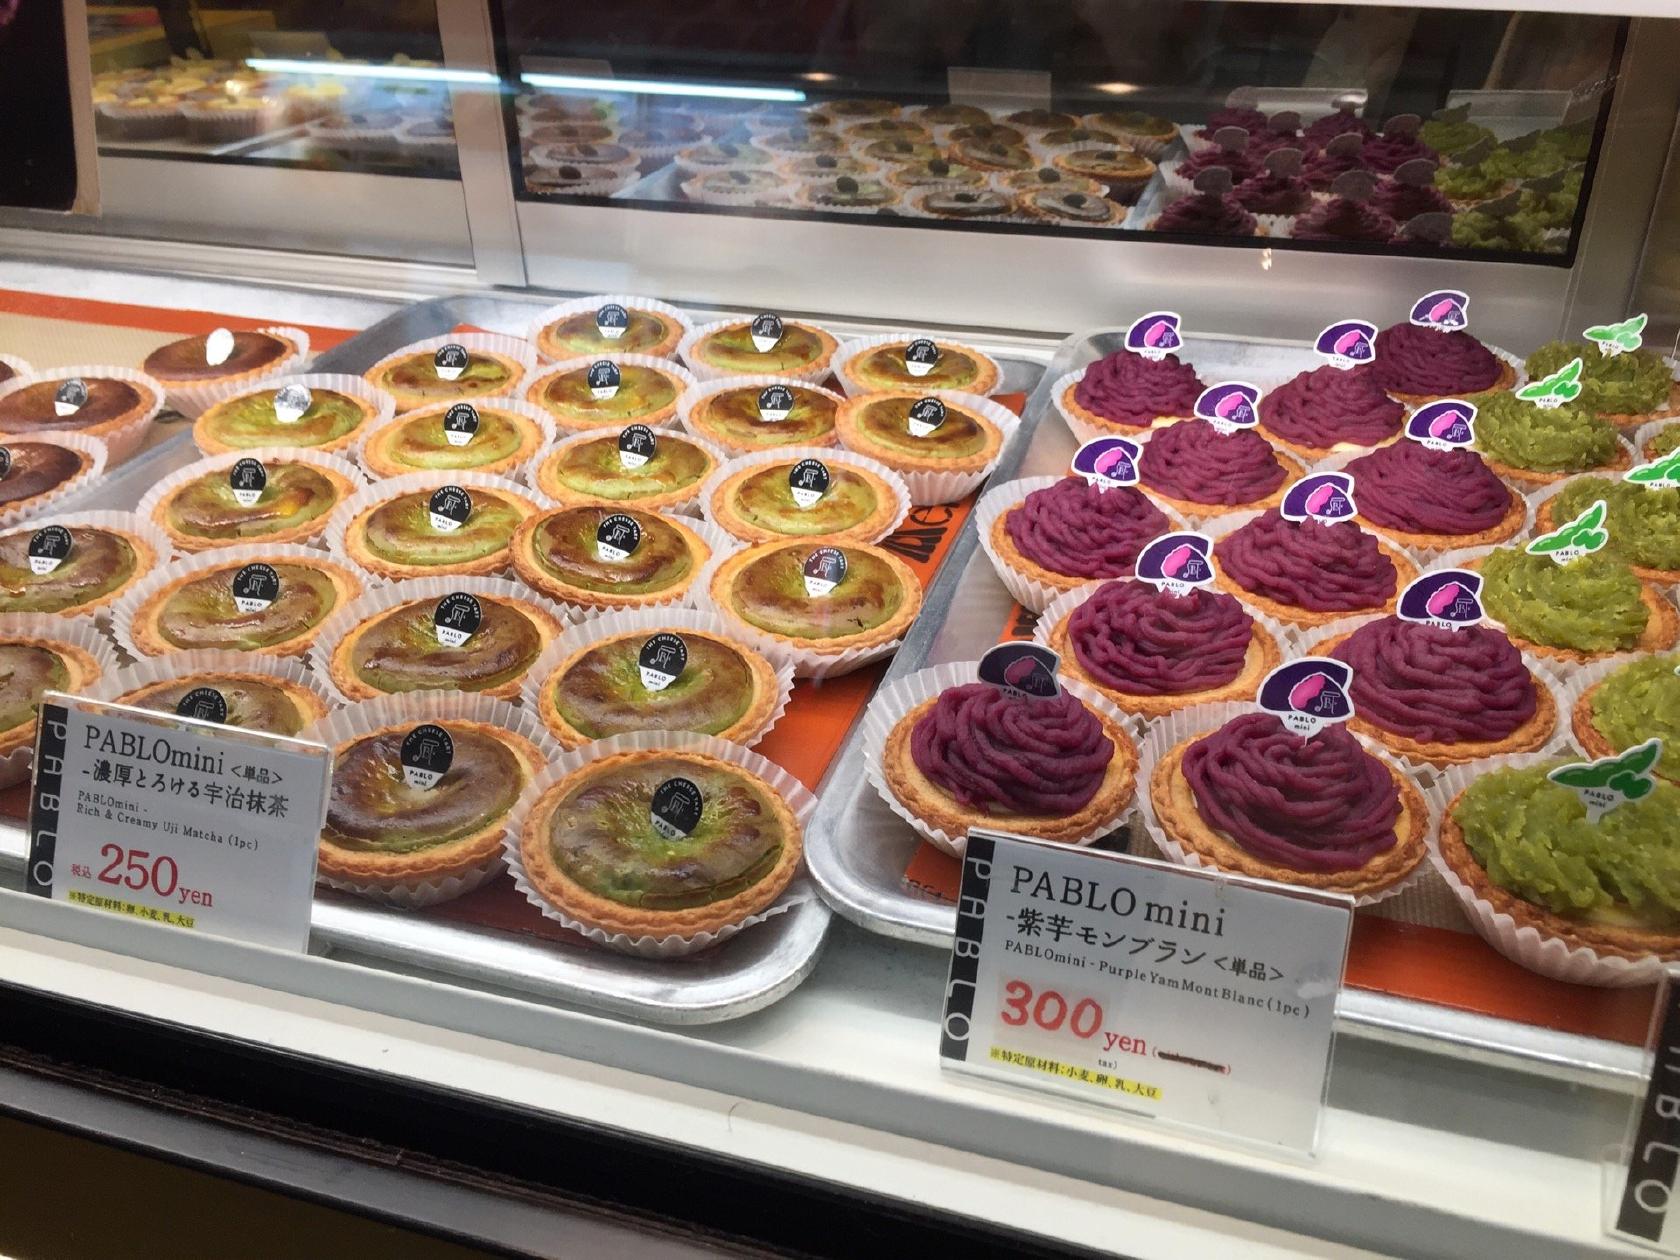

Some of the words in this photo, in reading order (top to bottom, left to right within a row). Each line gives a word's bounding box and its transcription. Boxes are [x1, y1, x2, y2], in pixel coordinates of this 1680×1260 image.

[1288, 714, 1316, 724] PABLO
[84, 725, 224, 775] PABLOmini
[409, 770, 433, 780] PABLO
[33, 720, 67, 887] PABLO
[78, 790, 140, 812] PABLOmini
[1584, 789, 1614, 801] PABLO
[76, 802, 100, 817] Rich
[104, 809, 113, 820] &
[117, 812, 158, 831] Creamy
[163, 821, 179, 835] Uji
[183, 825, 223, 844] Matcha
[228, 832, 259, 851] (1pc)
[71, 863, 92, 879] 税込
[98, 843, 178, 896] 250
[178, 887, 213, 907] yen
[944, 857, 992, 1041] PABLO
[1005, 939, 1086, 968] PABLOmini
[1099, 960, 1147, 982] Purple
[1150, 971, 1179, 989] Yam
[1182, 978, 1218, 998] Mont
[1222, 988, 1264, 1008] Blanc
[1001, 980, 1104, 1039] 300
[1103, 1031, 1147, 1057] yen
